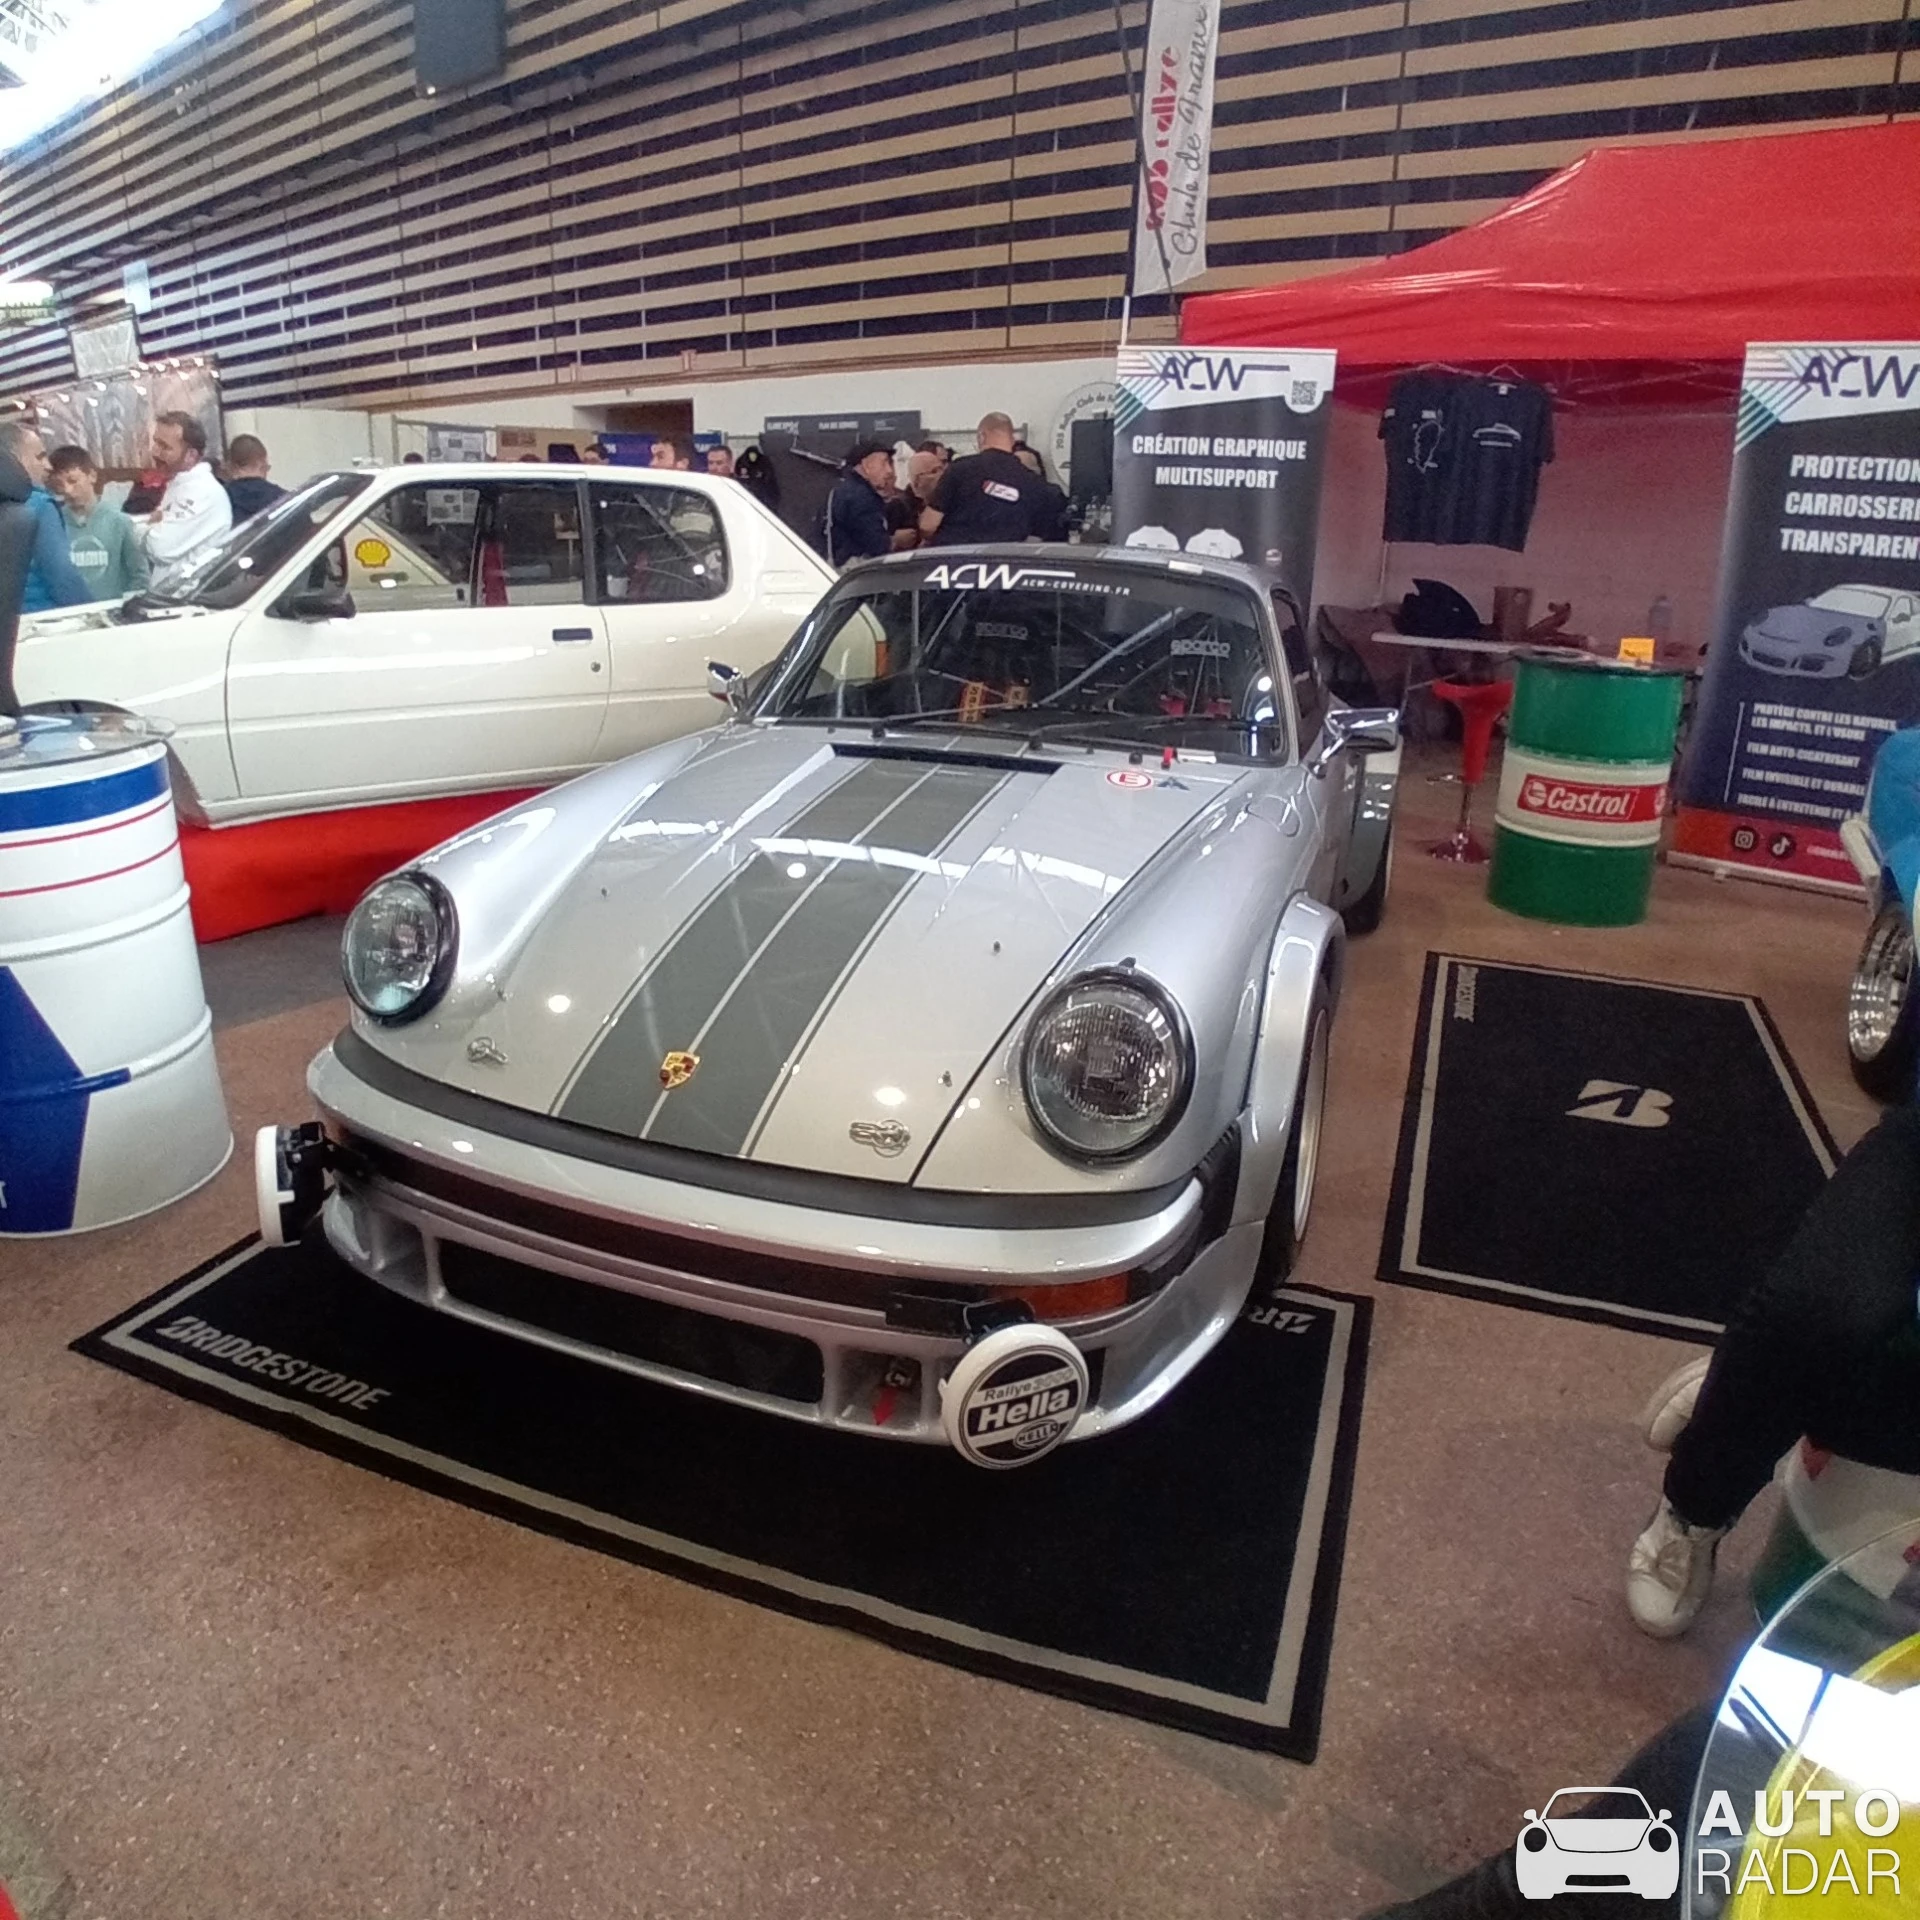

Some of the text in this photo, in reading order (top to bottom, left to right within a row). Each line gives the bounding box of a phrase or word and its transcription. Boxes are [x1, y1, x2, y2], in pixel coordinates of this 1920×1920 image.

[1175, 133, 1202, 171] de
[1160, 356, 1268, 392] ACW
[1800, 355, 1920, 398] ACW
[1077, 394, 1095, 408] Club
[1132, 433, 1307, 460] CRÉATION GRAPHIQUE
[1155, 467, 1278, 488] MULTISUPPORT
[924, 563, 1046, 590] ACW
[1022, 578, 1131, 596] ACW-COVERING.FR
[1170, 639, 1231, 658] sparco
[1547, 786, 1632, 816] Castrol
[155, 1316, 392, 1412] BRIDGESTONE
[984, 1381, 1033, 1402] Rallye
[977, 1387, 1070, 1432] Hella
